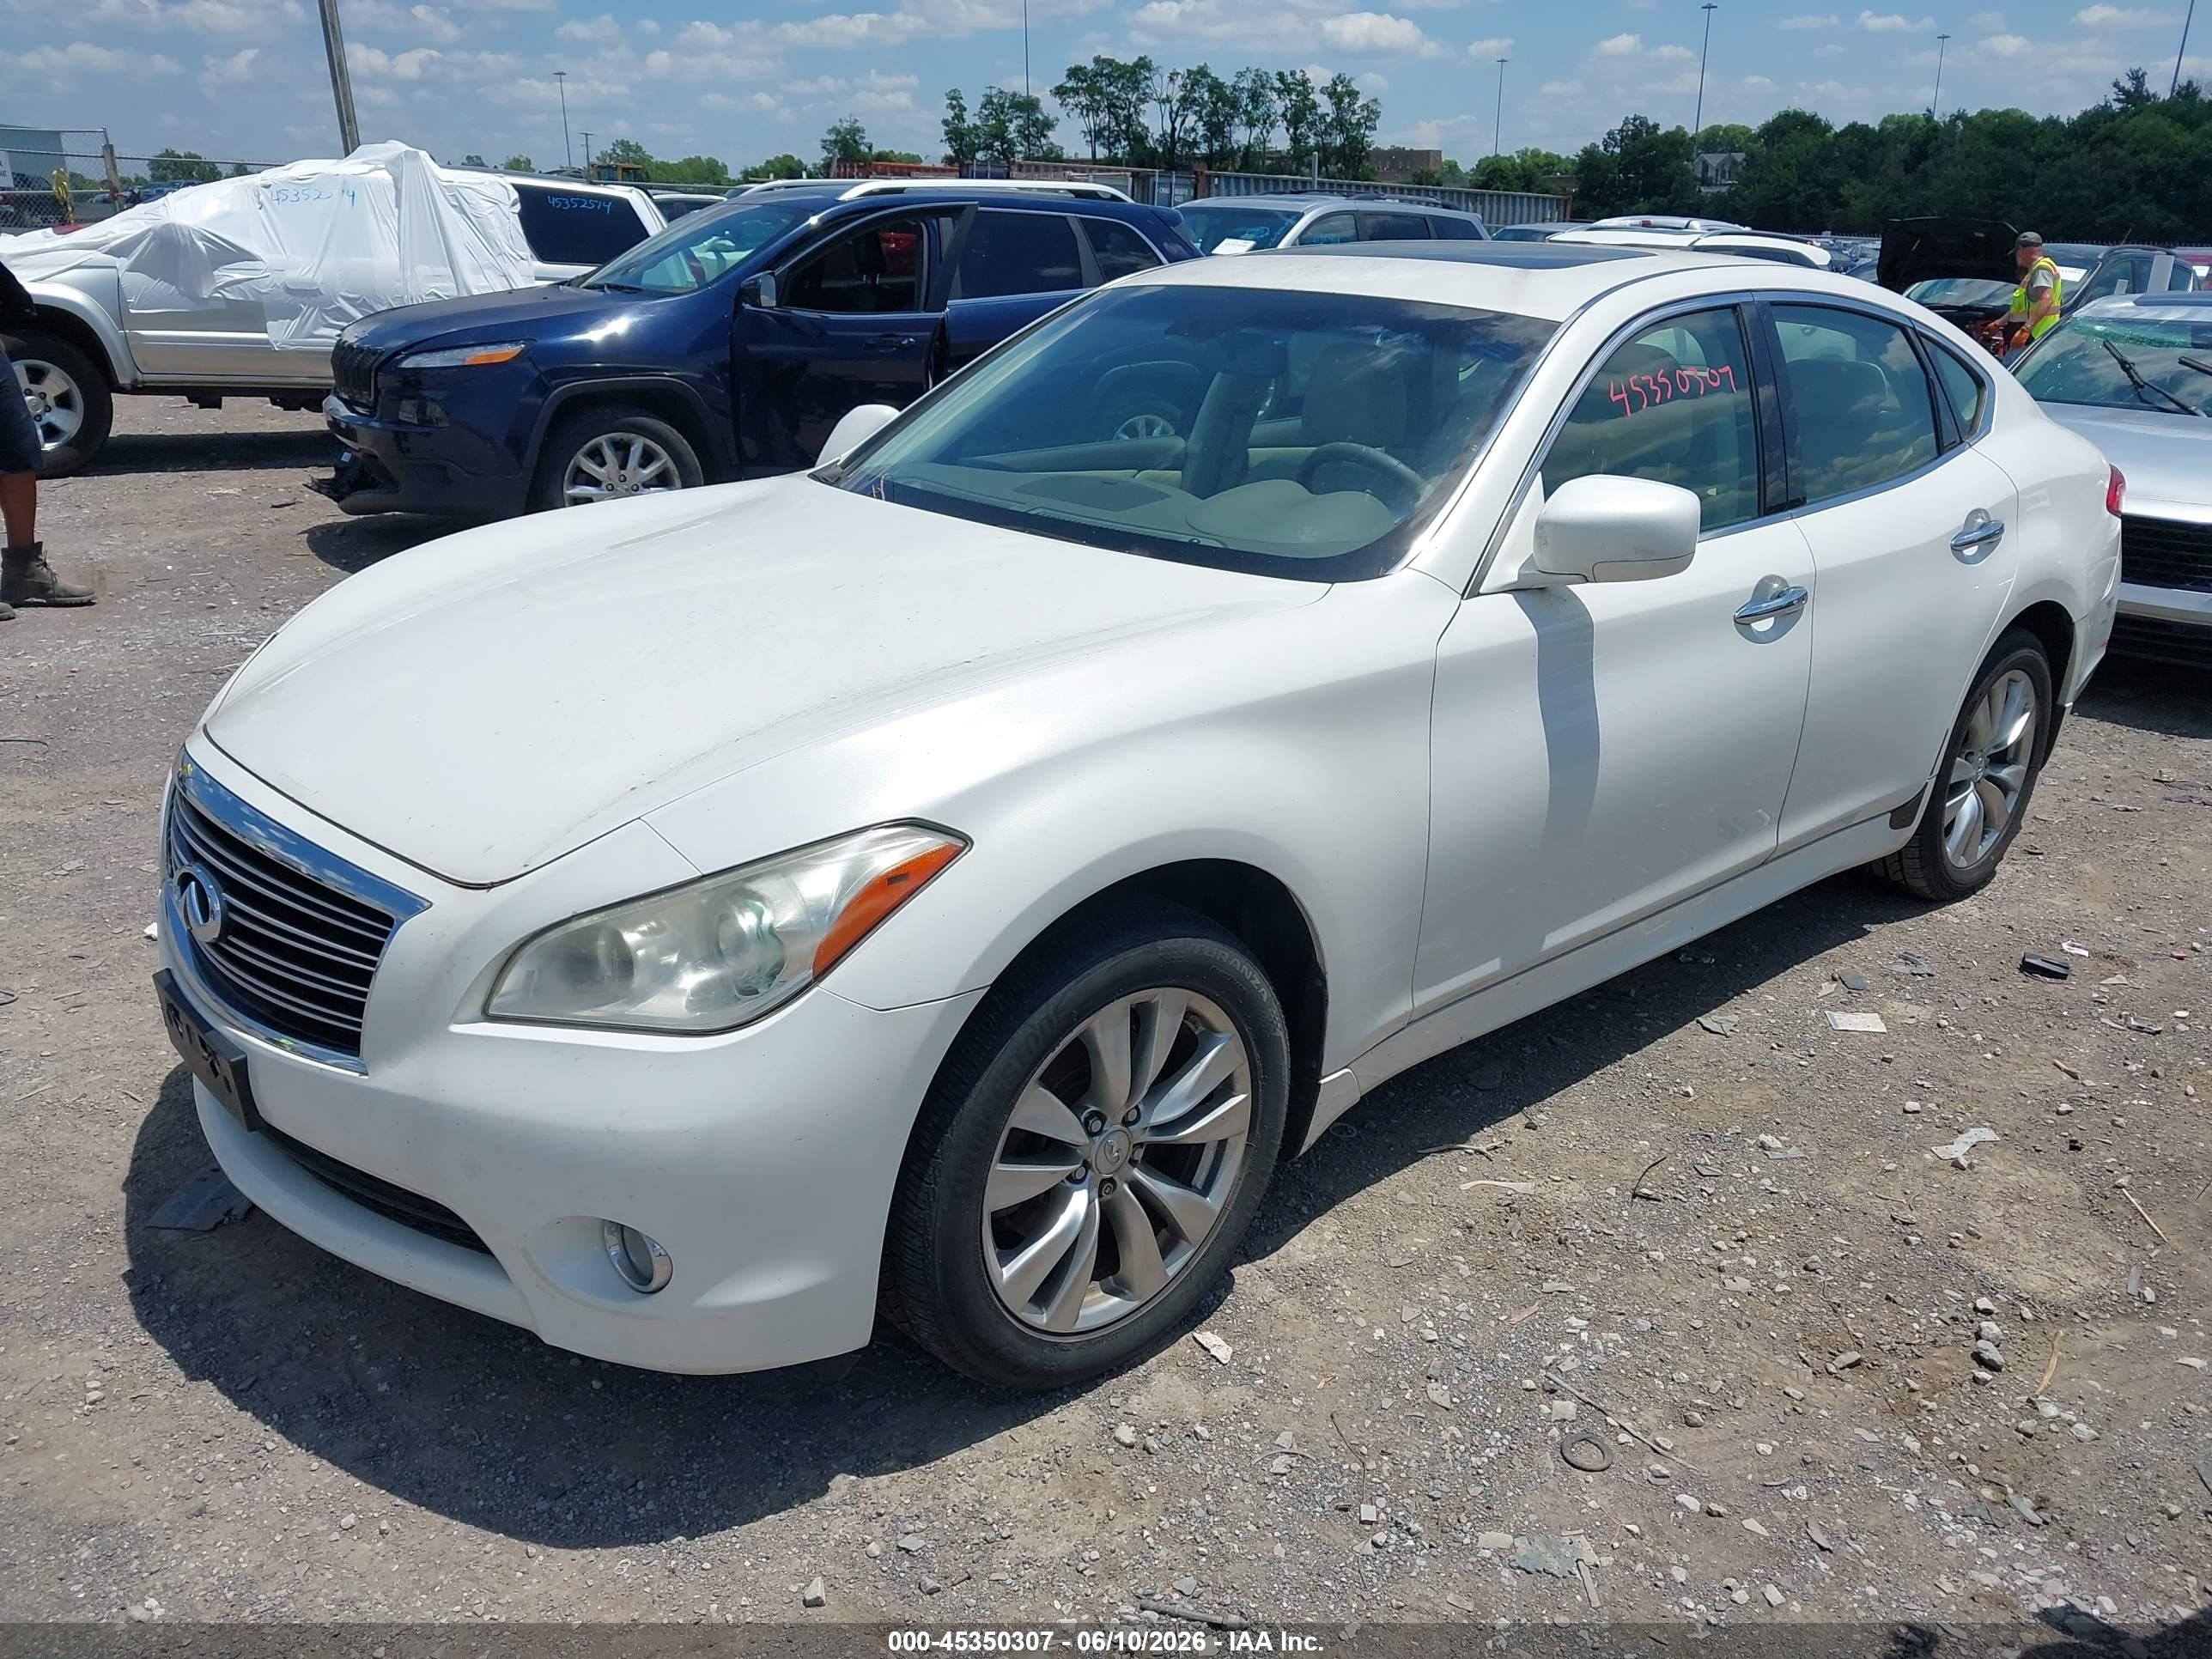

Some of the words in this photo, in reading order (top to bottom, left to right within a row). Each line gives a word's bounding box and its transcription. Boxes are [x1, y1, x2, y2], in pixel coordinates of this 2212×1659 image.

[270, 188, 356, 207] 453524
[547, 195, 612, 215] 45352514
[1609, 365, 1737, 417] 45350307
[1188, 943, 1268, 1003] TURANZA
